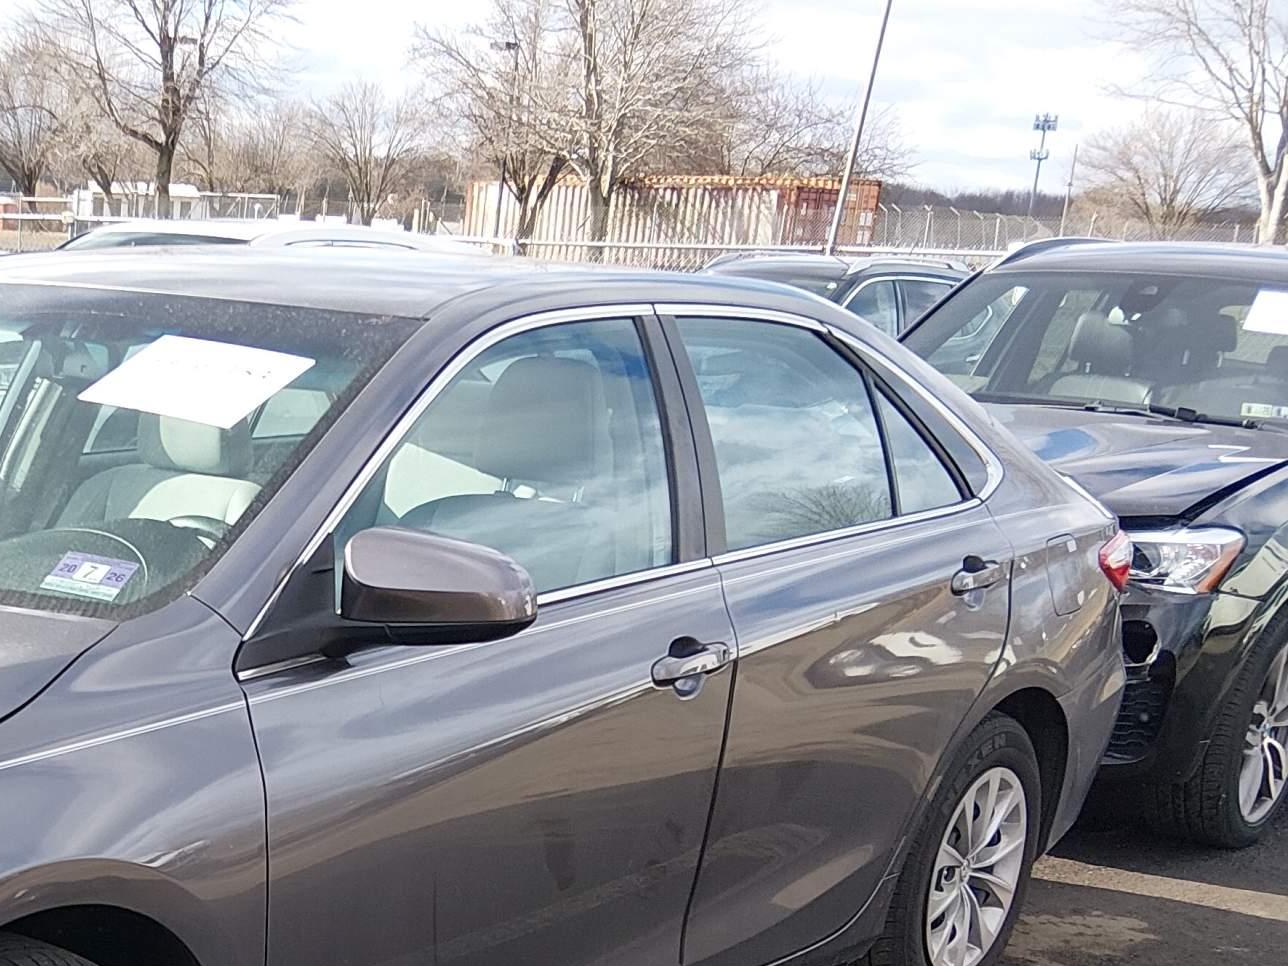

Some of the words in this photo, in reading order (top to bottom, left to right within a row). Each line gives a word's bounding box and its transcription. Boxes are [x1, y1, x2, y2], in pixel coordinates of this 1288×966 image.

[58, 563, 77, 573] 20
[83, 565, 99, 579] 7
[106, 572, 126, 583] 26
